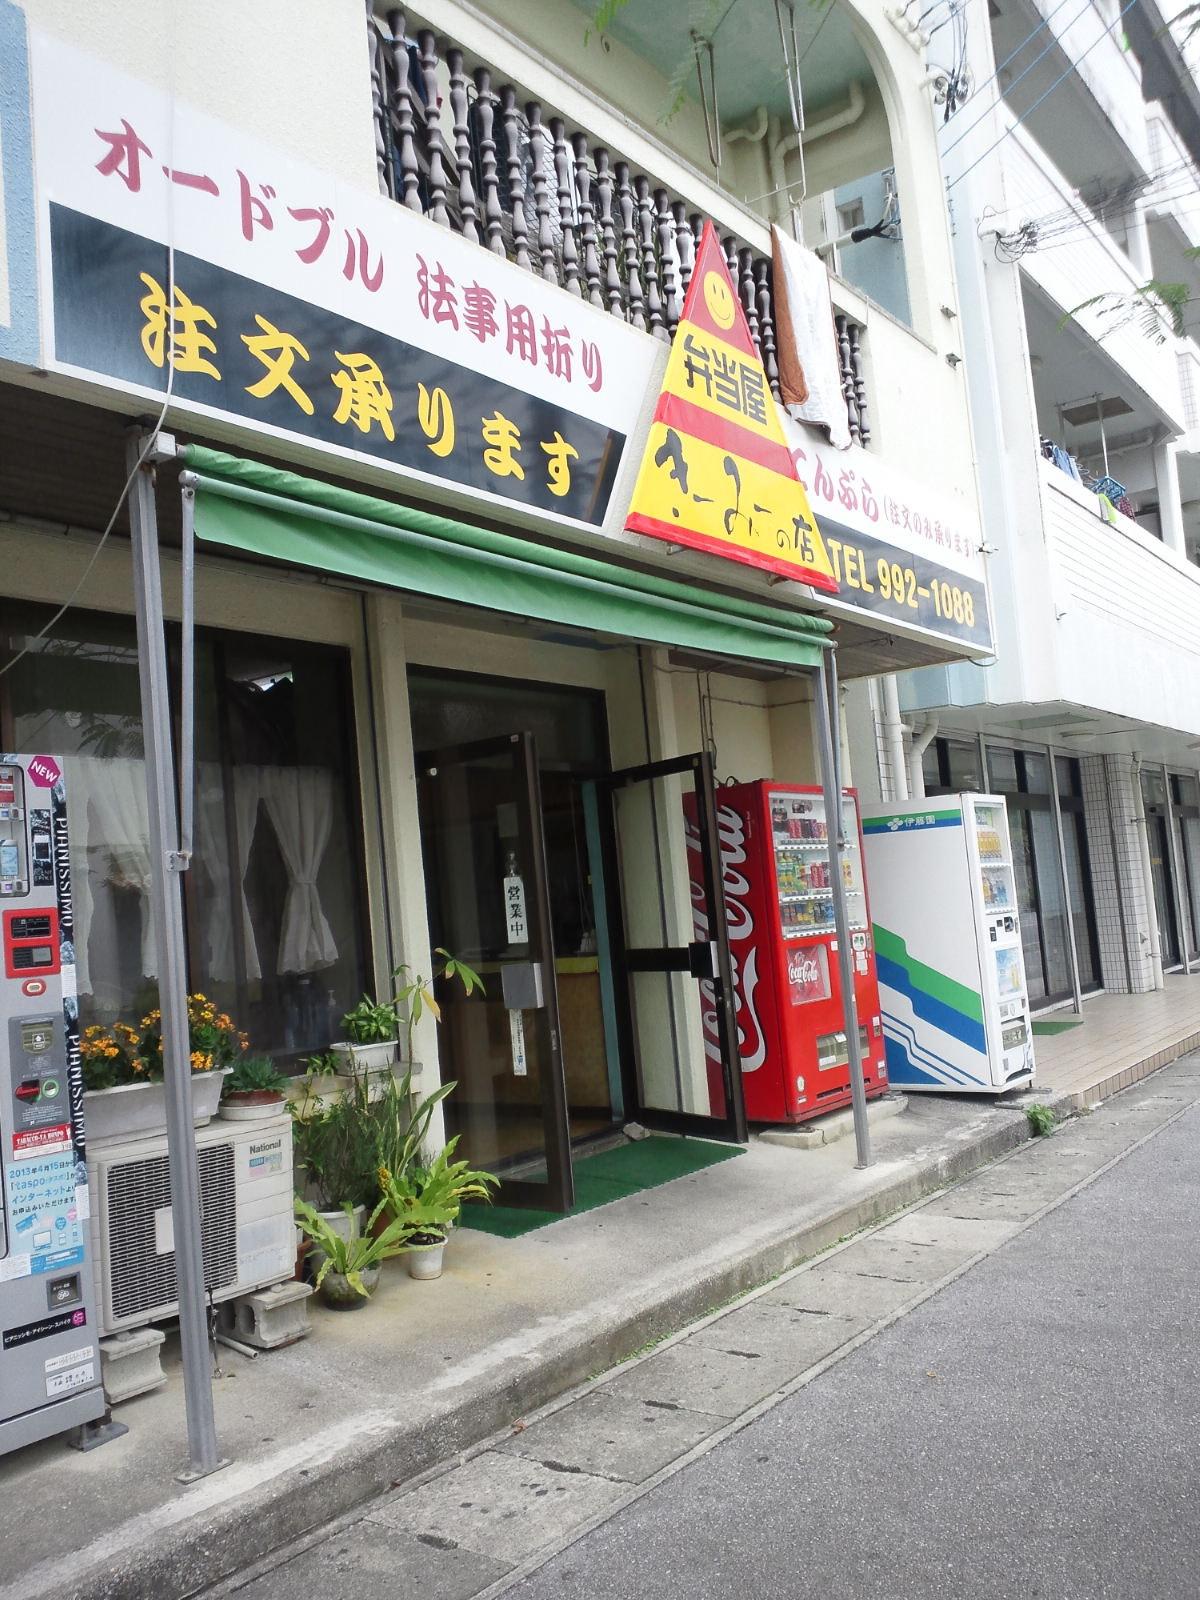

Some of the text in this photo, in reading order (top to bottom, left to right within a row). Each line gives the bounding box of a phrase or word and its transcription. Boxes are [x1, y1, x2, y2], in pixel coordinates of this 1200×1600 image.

[94, 118, 605, 393] オードブル 法事用折り
[139, 271, 580, 498] 注文承ります
[683, 333, 768, 426] 弁当屋
[826, 538, 975, 628] TEL 992-1088
[30, 760, 58, 783] NEW
[507, 885, 524, 937] 営業中
[249, 1139, 281, 1155] National
